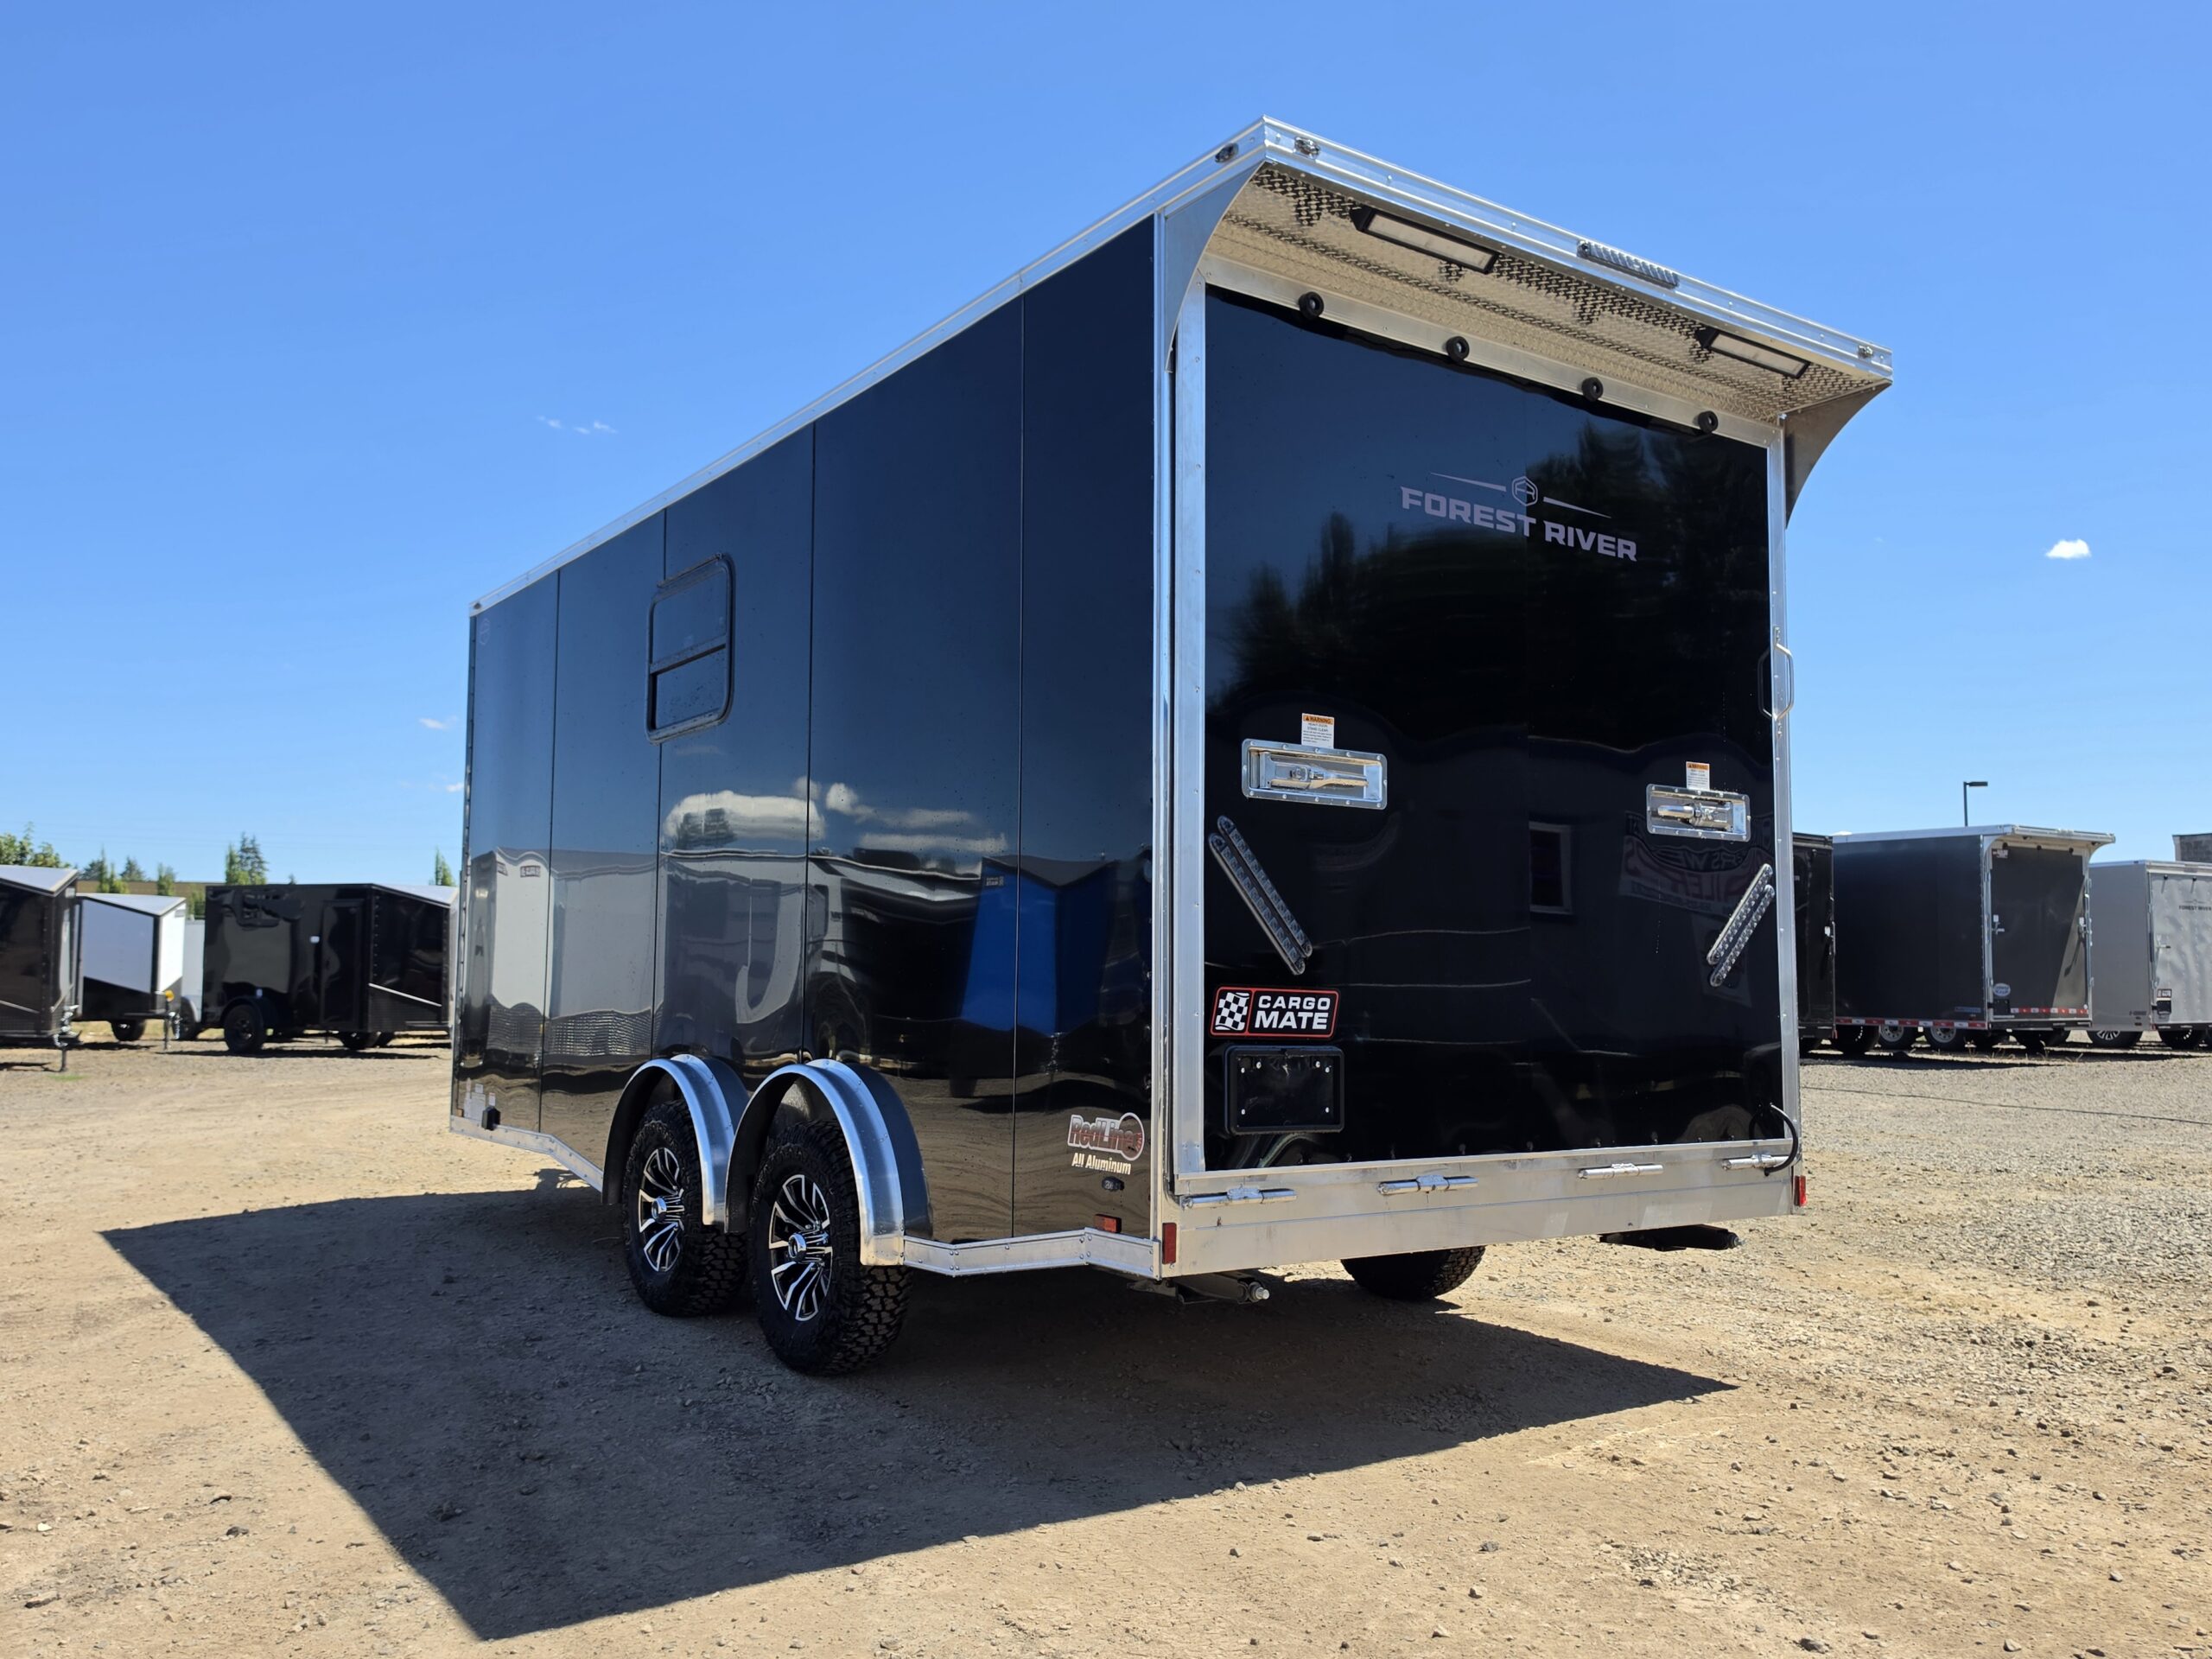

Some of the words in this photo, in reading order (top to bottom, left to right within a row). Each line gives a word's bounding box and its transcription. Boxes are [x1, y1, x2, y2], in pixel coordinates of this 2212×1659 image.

[1401, 486, 1536, 537] FOREST
[1543, 519, 1637, 561] RIVER
[1258, 995, 1331, 1010] CARGO
[1255, 1010, 1329, 1029] MATE
[1071, 1153, 1084, 1167] All
[1085, 1154, 1131, 1175] Aluminum
